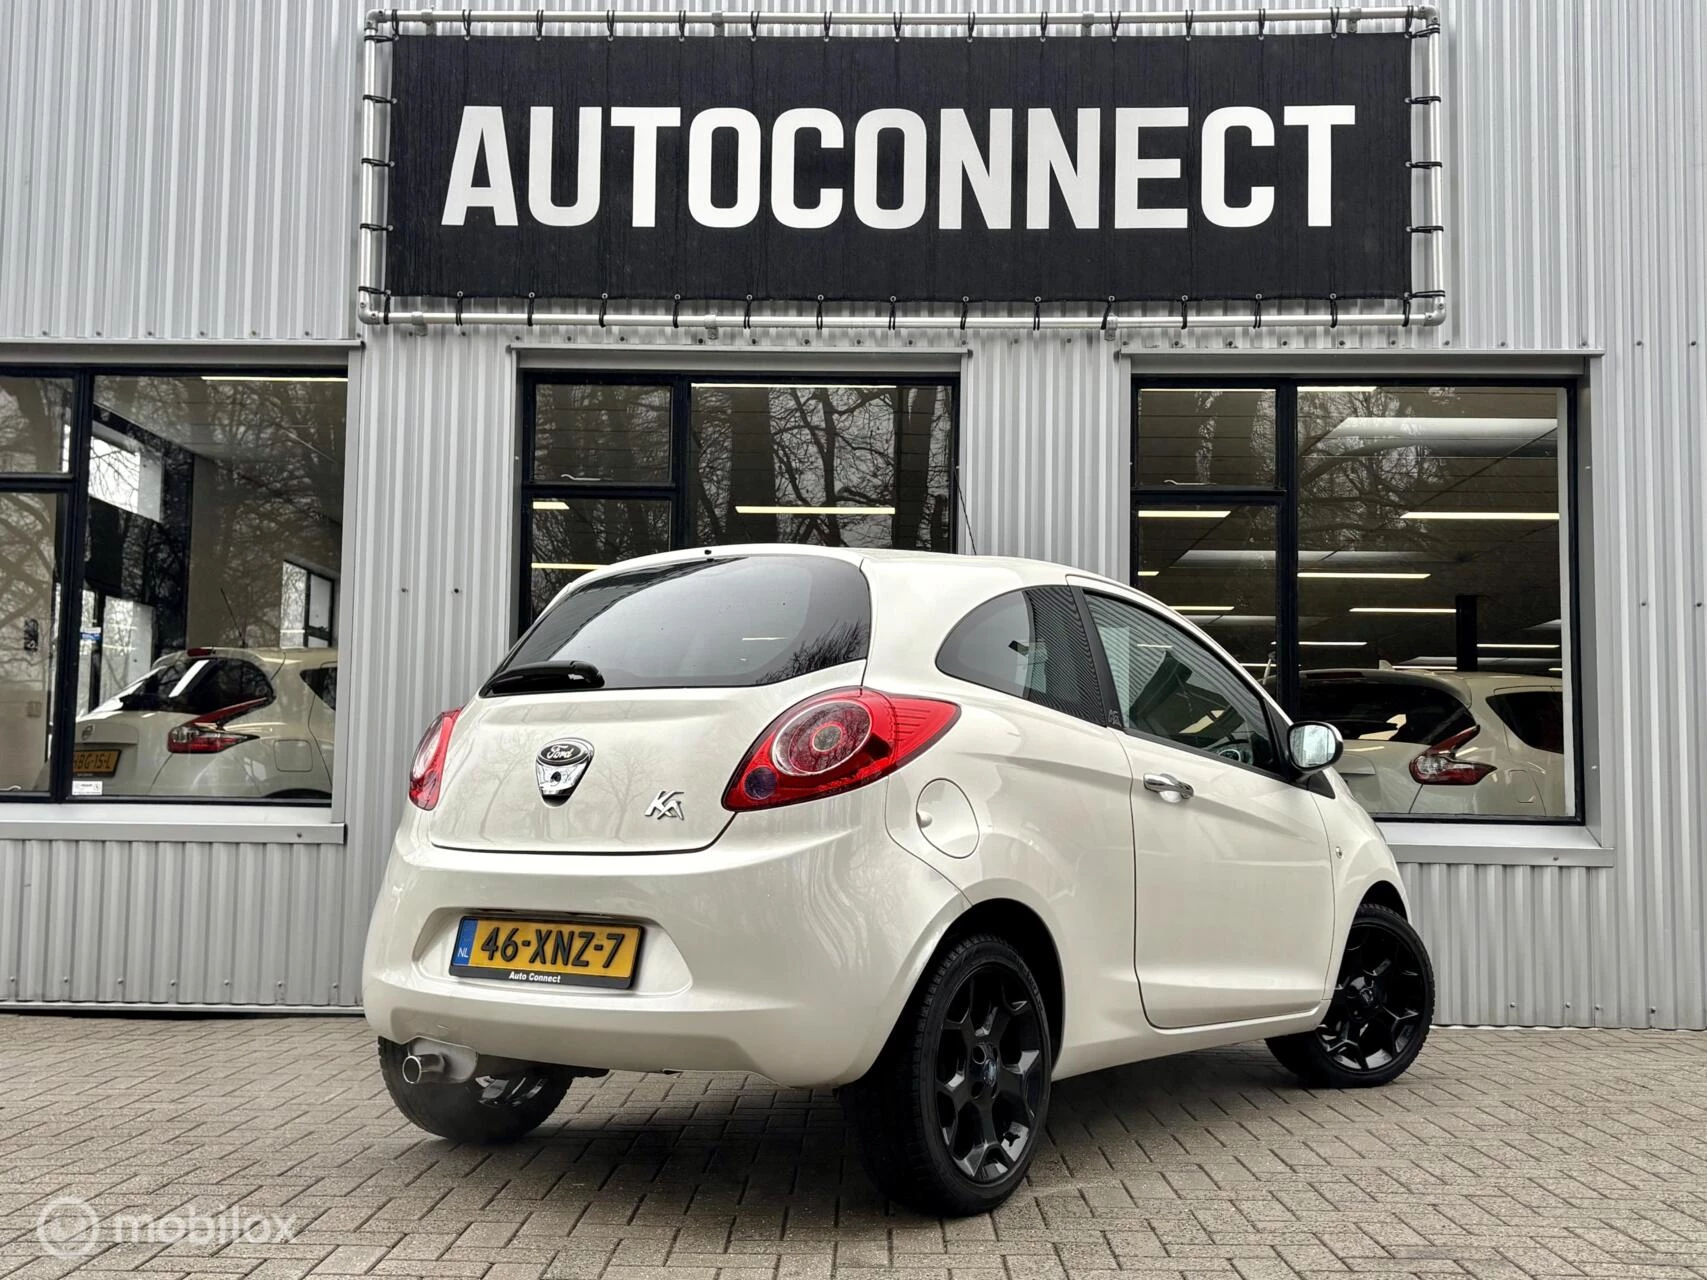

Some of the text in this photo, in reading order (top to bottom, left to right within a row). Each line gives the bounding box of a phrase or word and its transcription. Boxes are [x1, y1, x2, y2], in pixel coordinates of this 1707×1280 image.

[441, 104, 1355, 230] AUTOCONNECT
[546, 744, 575, 759] Ford
[457, 947, 469, 959] NL
[480, 926, 626, 969] 46-XNZ-7
[508, 971, 561, 984] Auto Connect
